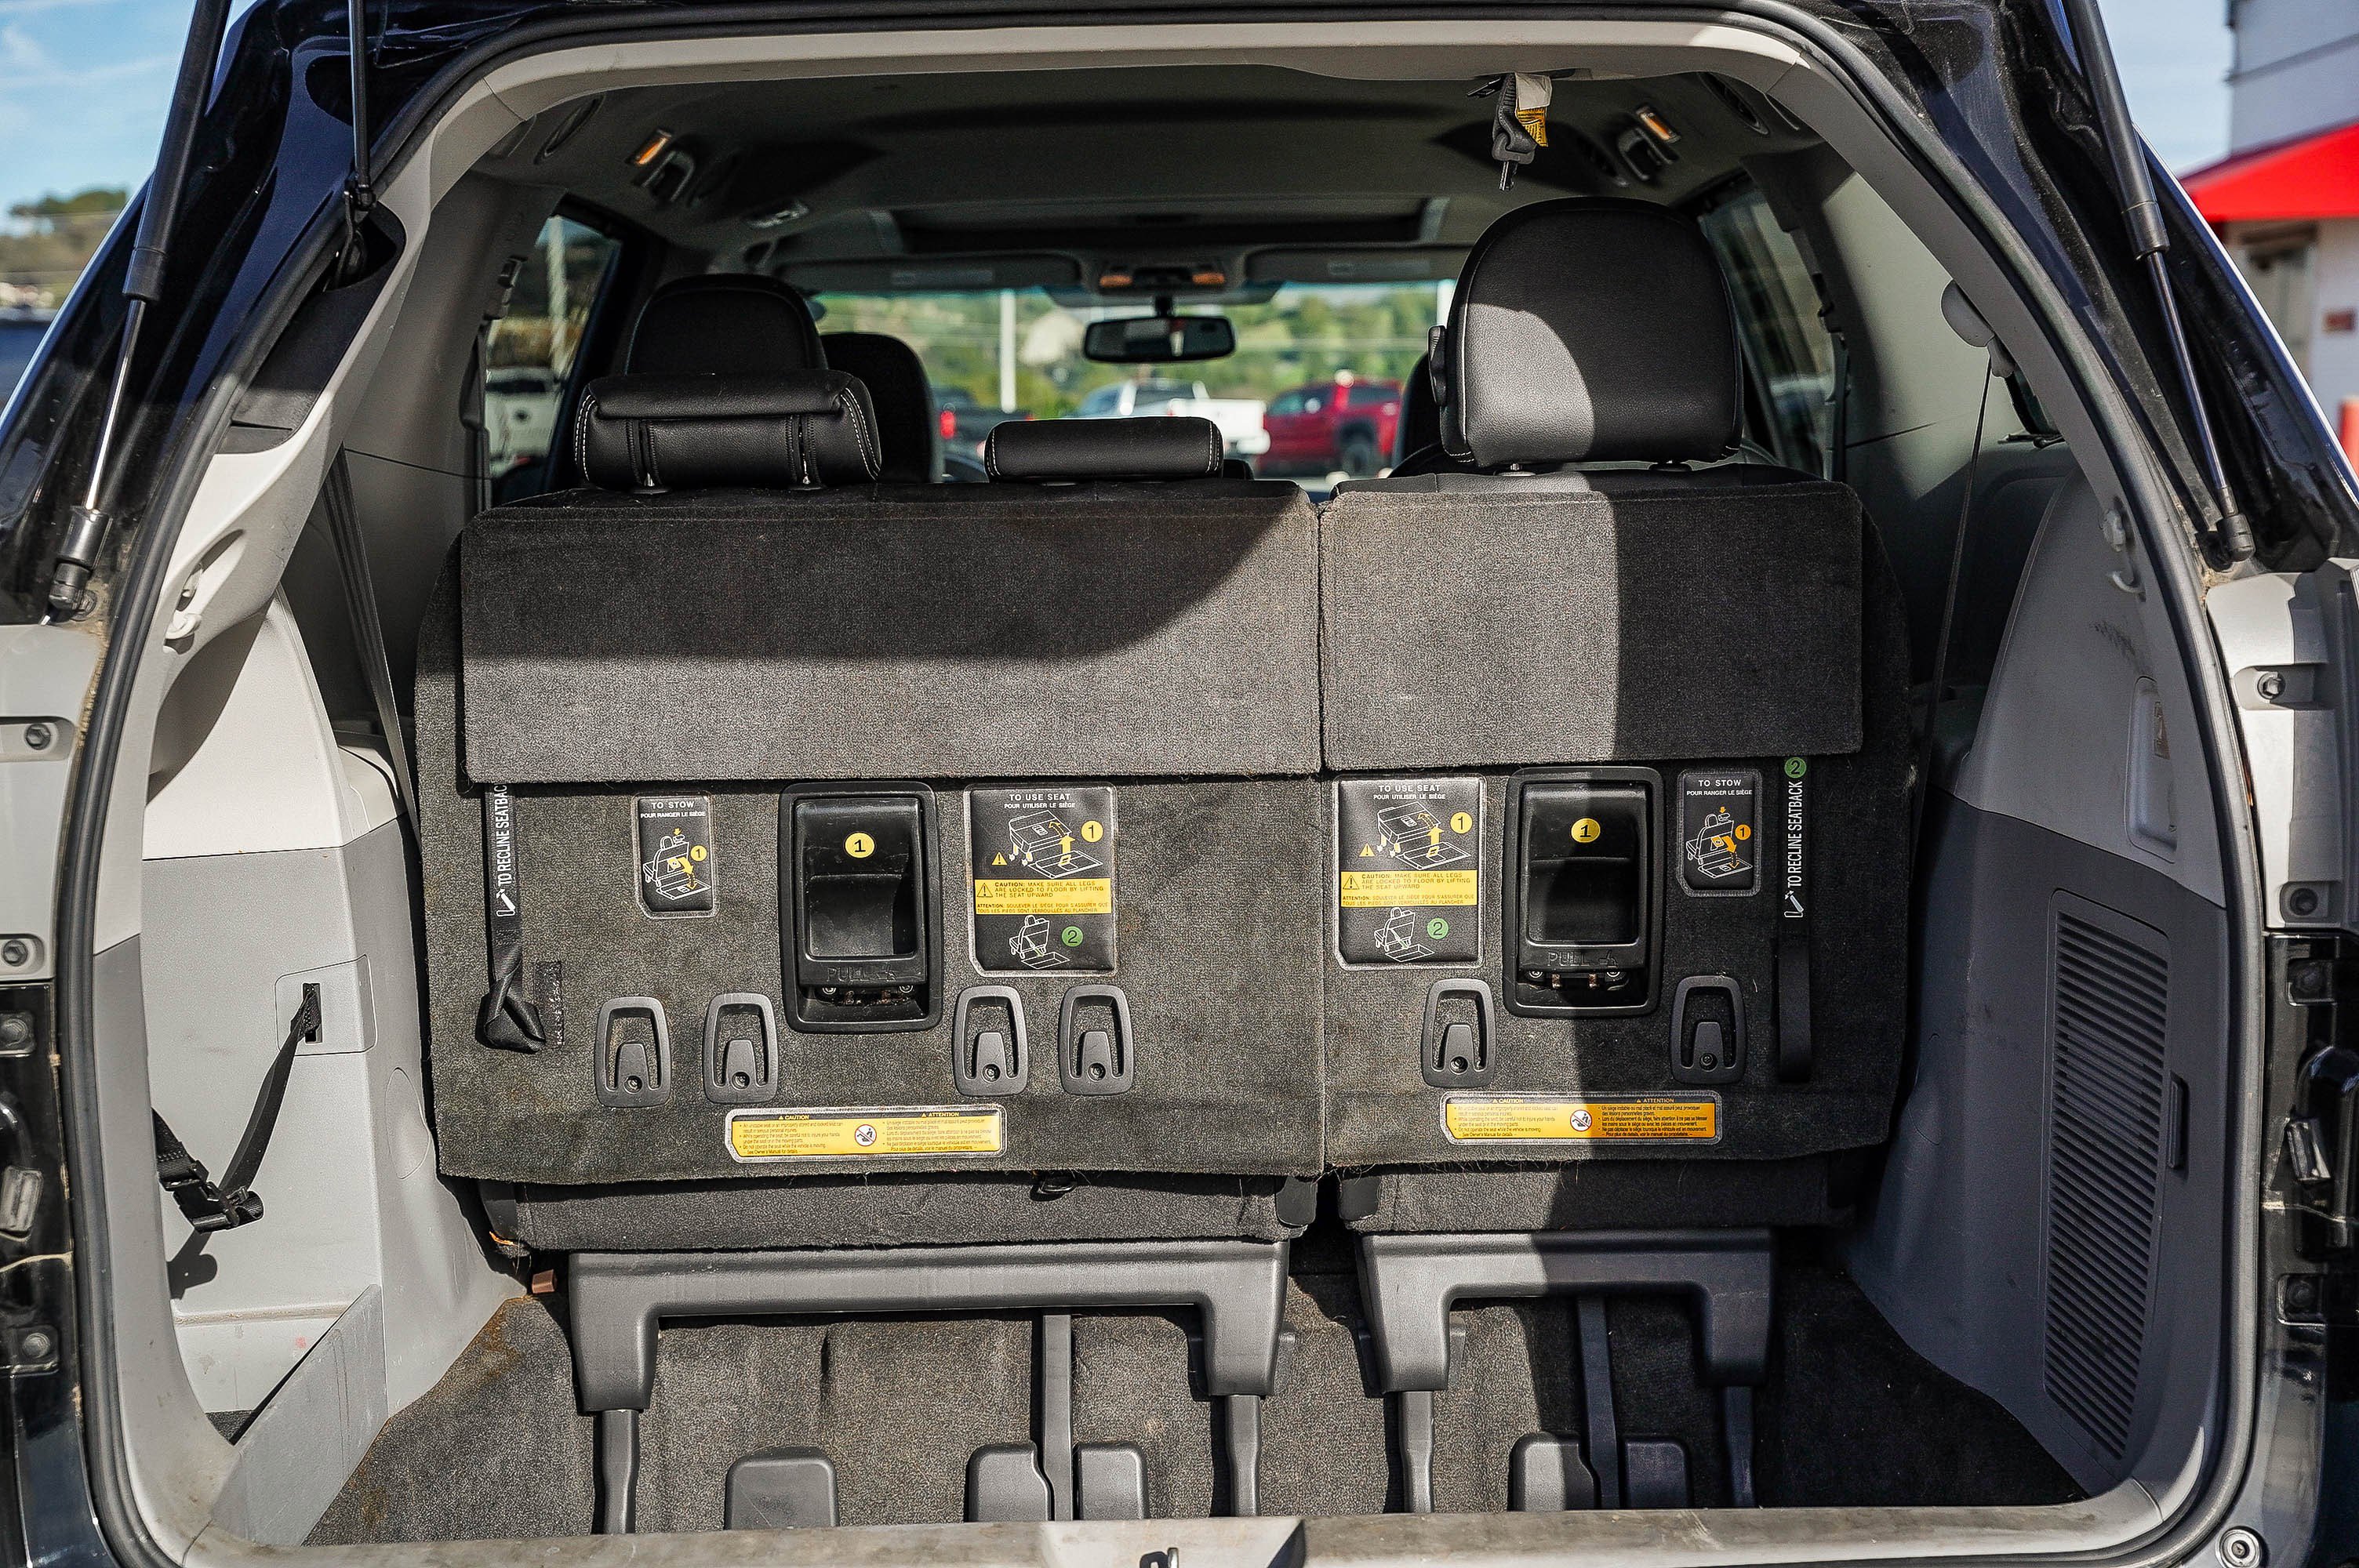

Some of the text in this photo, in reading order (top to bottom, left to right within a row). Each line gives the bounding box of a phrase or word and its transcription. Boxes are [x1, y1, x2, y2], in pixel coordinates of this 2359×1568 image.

[1790, 760, 1801, 775] 2
[493, 782, 512, 887] TO RECLINE SEATBAC
[1579, 825, 1592, 838] 1
[1787, 781, 1803, 888] TO RECLINE SEATBACK
[855, 839, 866, 852] 1
[1433, 921, 1443, 935] 2
[1067, 930, 1078, 944] 2
[1547, 951, 1590, 966] PULL
[827, 966, 871, 982] PULL
